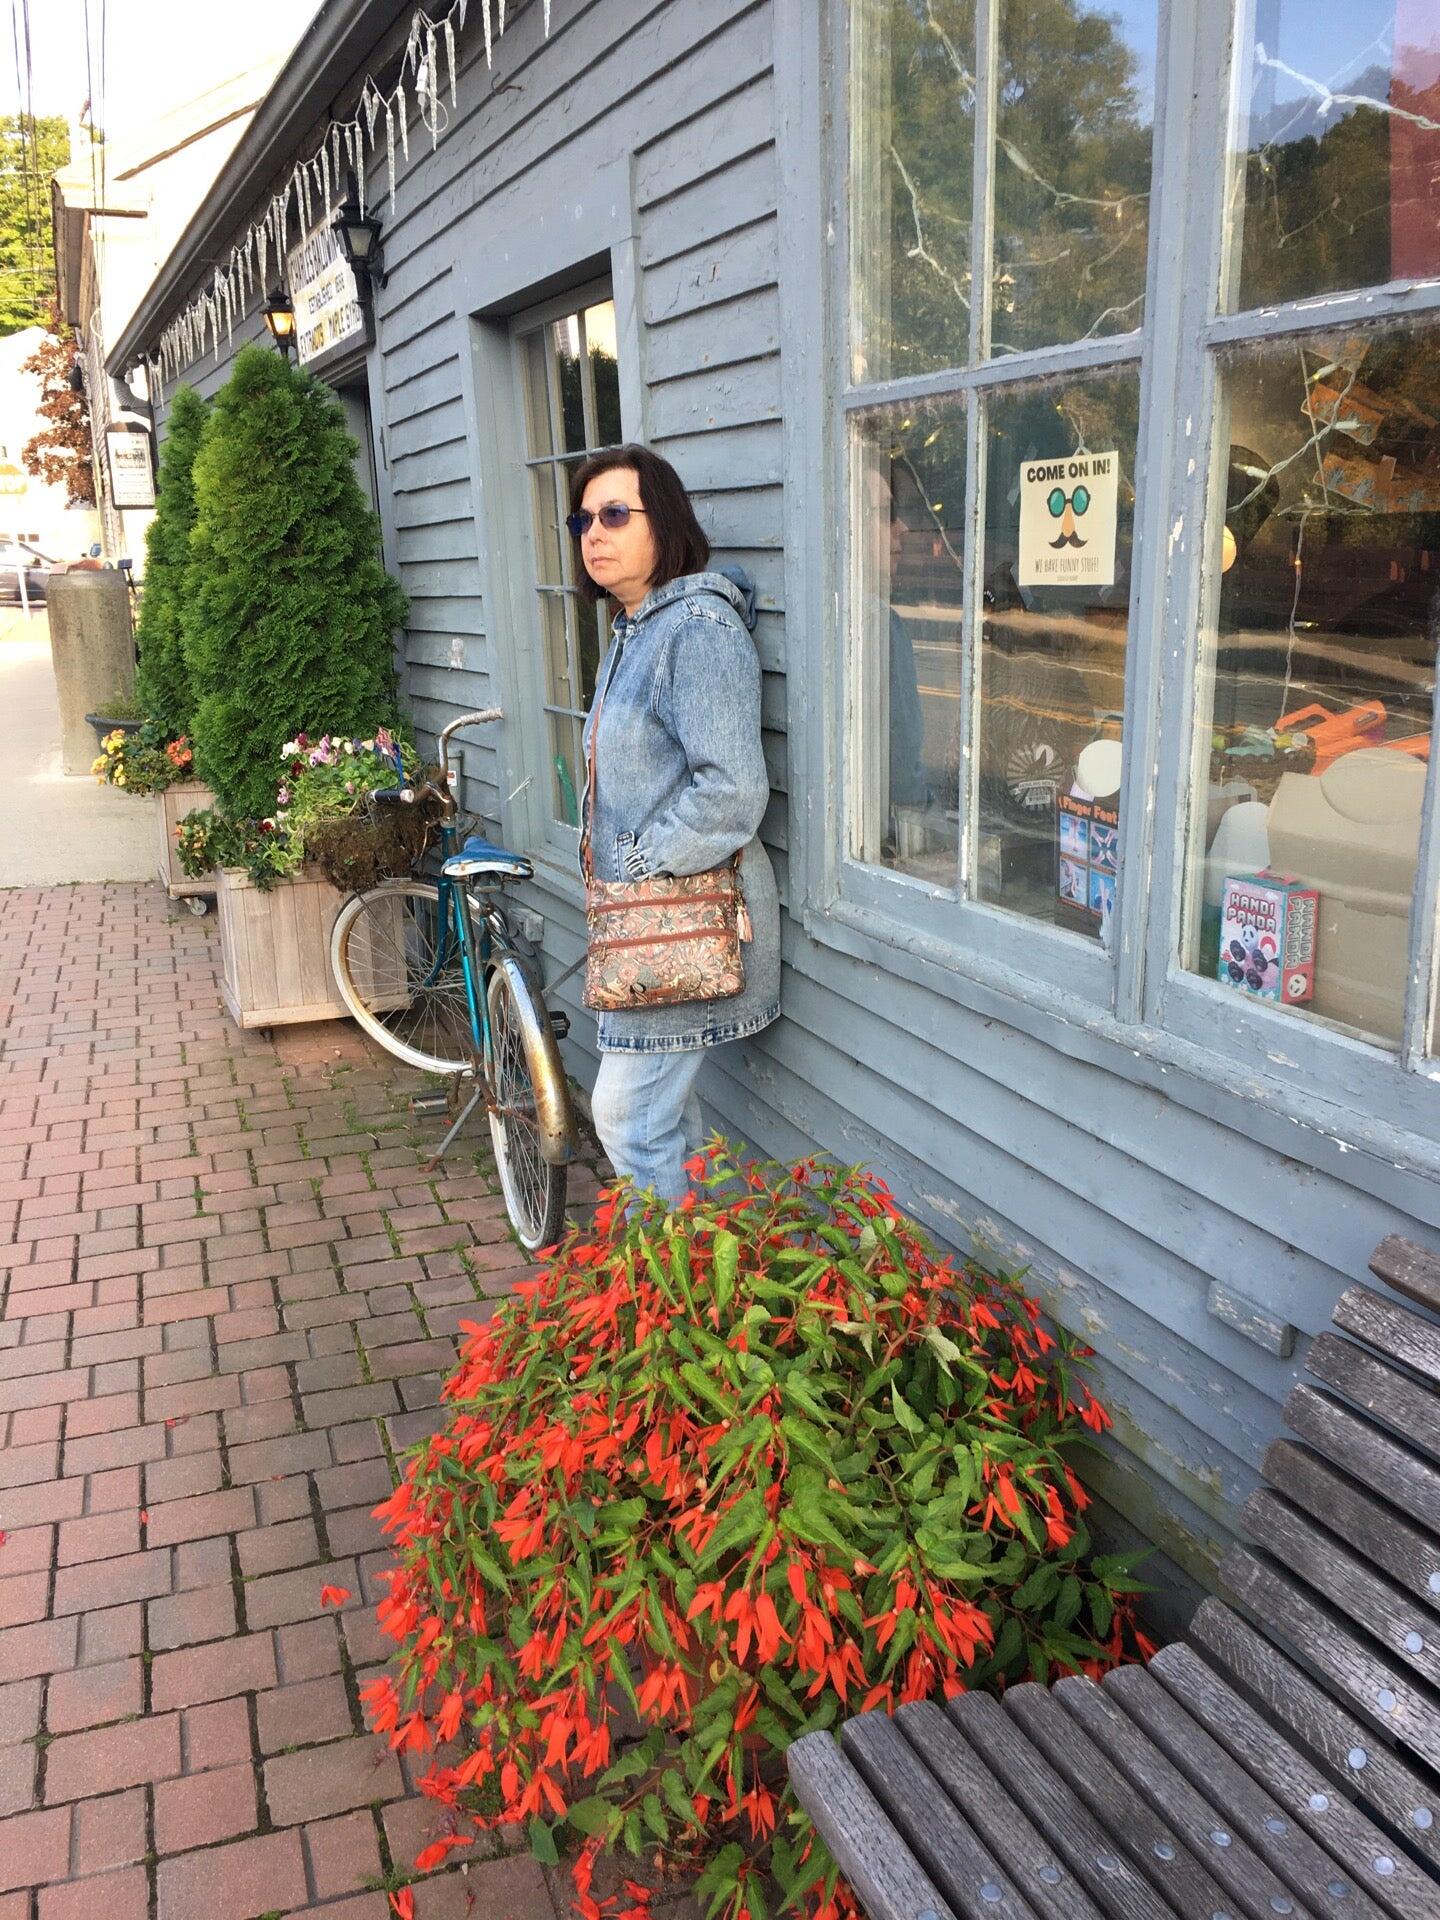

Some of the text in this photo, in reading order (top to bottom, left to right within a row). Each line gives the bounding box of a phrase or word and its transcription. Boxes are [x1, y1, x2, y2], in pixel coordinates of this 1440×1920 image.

[1027, 458, 1111, 483] COME ON IN!
[1034, 556, 1099, 573] WE HAVE FUNNY STUFF!
[1231, 892, 1275, 917] HANDI
[1226, 906, 1276, 934] PANDA
[1285, 896, 1303, 969] PANDA
[1301, 897, 1315, 964] HANDI
